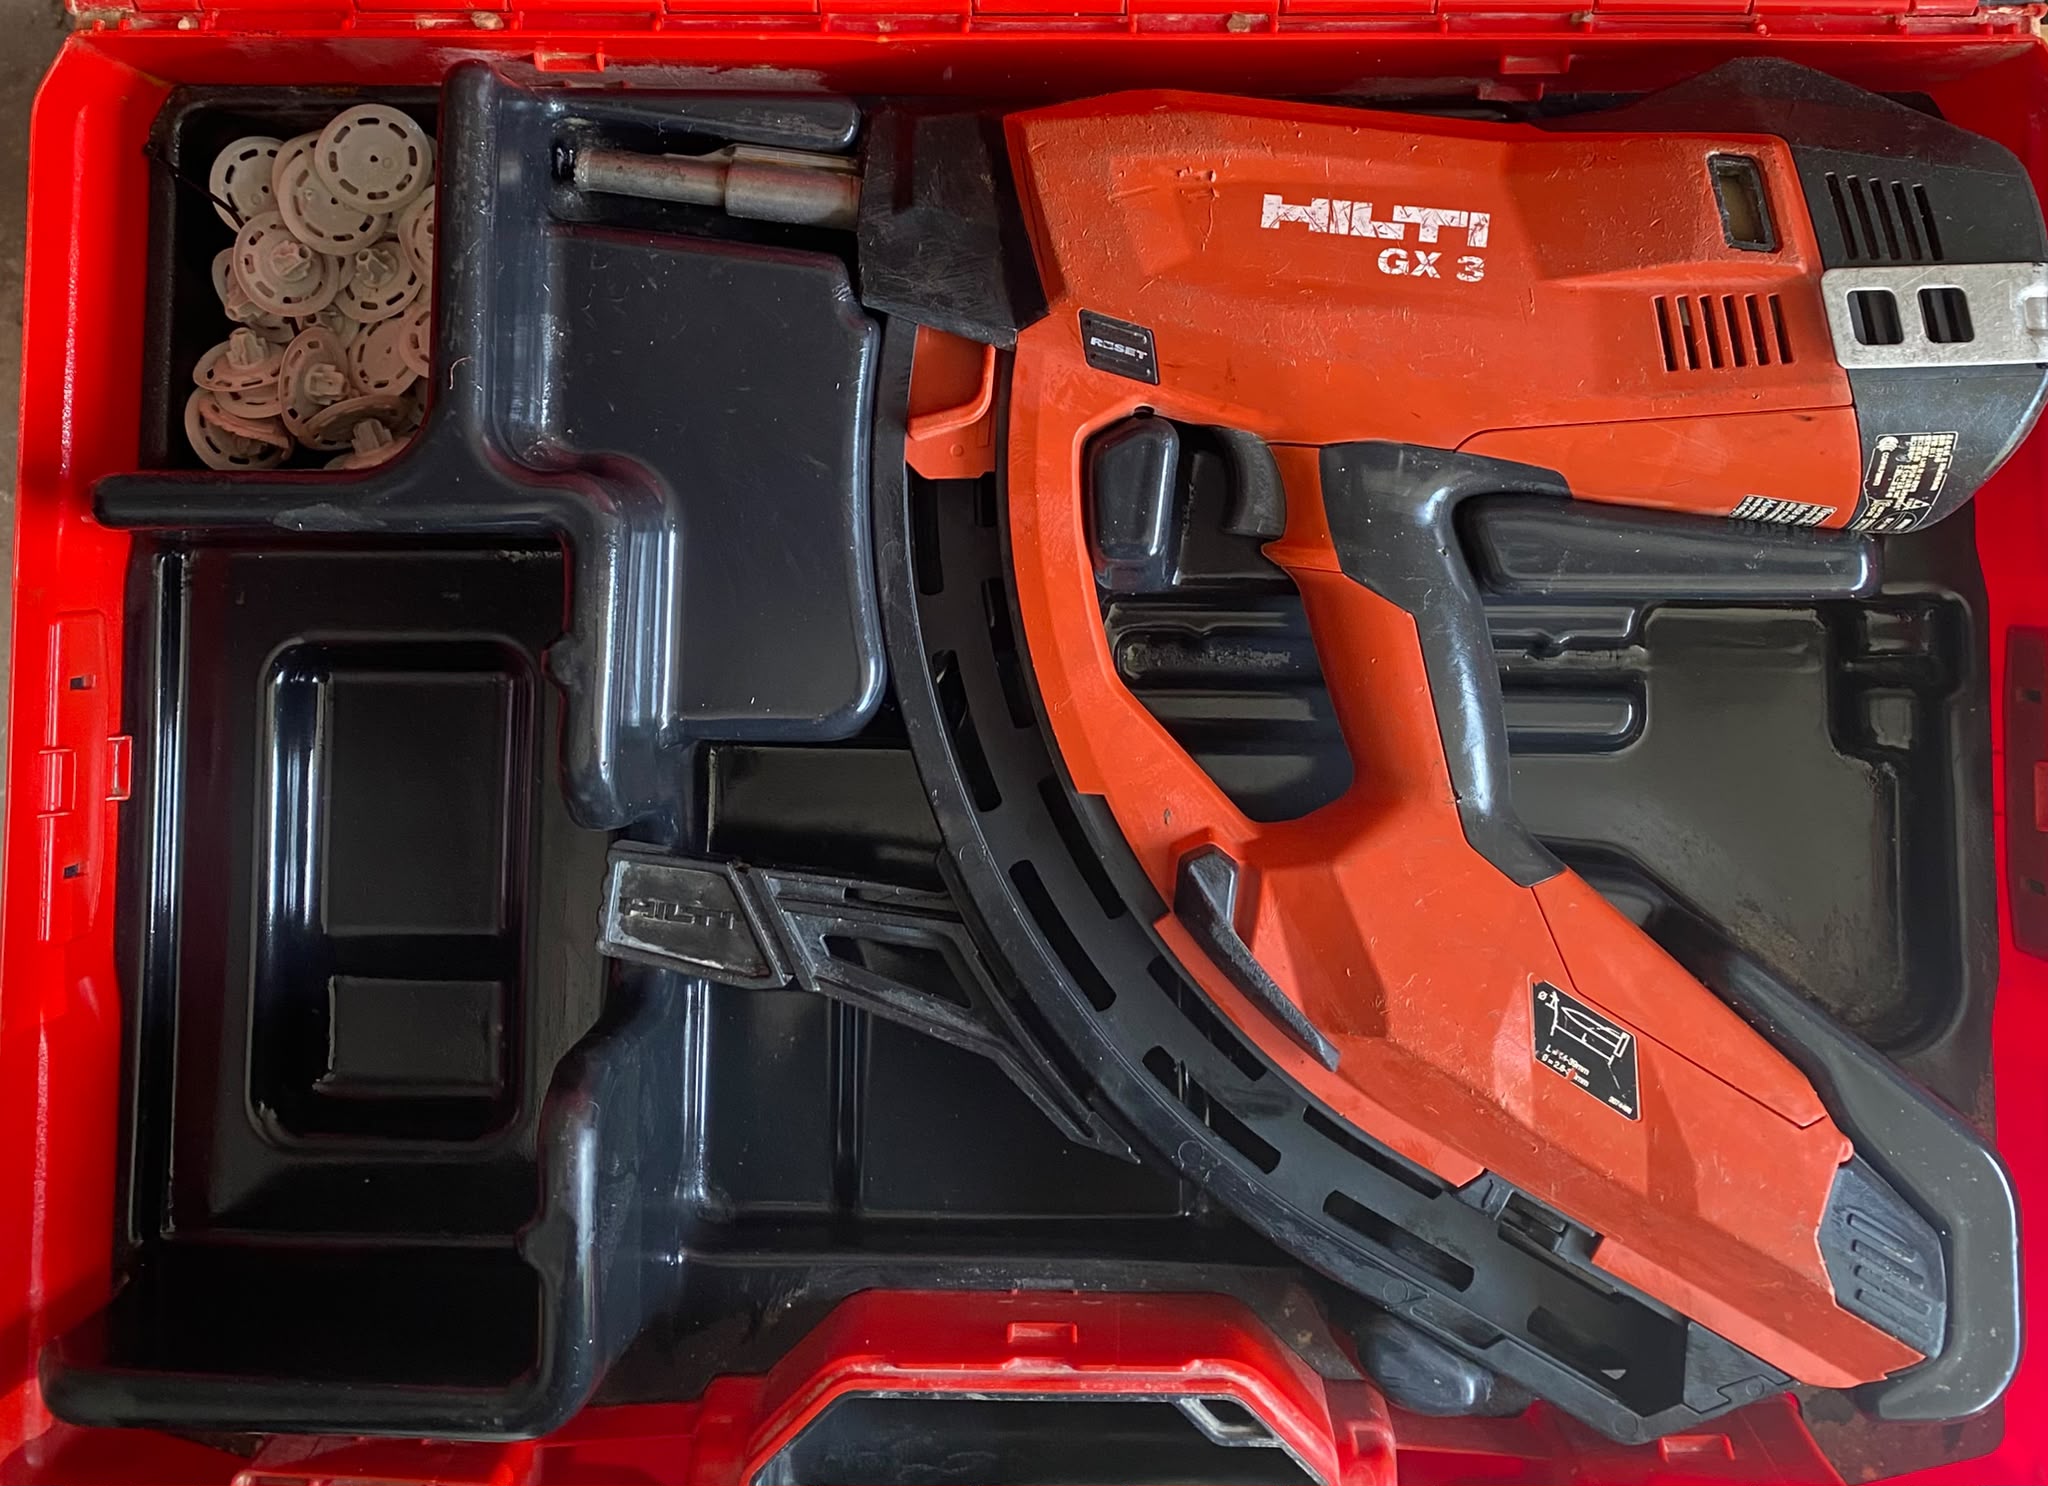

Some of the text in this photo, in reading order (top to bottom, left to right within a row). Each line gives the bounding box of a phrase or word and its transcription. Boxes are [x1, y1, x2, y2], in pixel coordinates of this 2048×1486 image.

[1260, 193, 1491, 248] HILTI
[1377, 247, 1486, 282] GX 3
